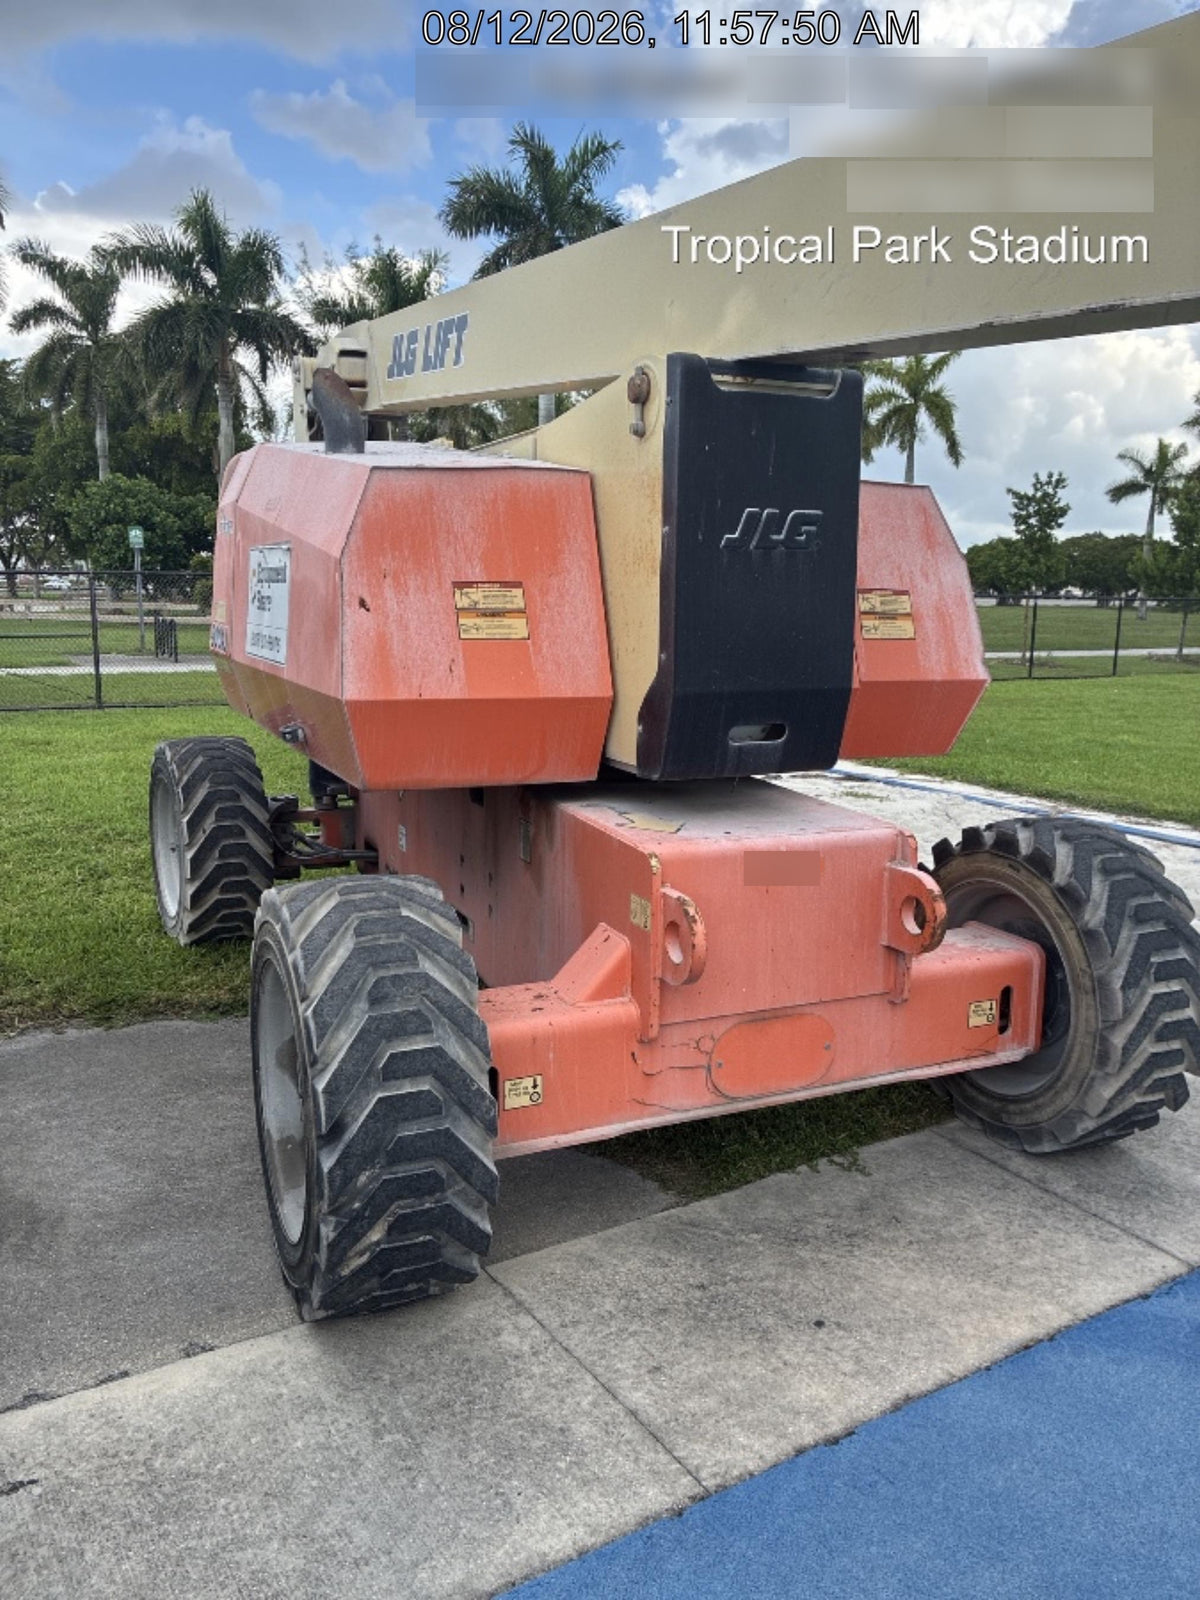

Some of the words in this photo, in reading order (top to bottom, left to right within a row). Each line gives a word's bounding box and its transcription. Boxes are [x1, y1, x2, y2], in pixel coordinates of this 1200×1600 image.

[387, 328, 418, 380] JLG
[421, 311, 468, 374] LIFT
[720, 507, 823, 550] JLG
